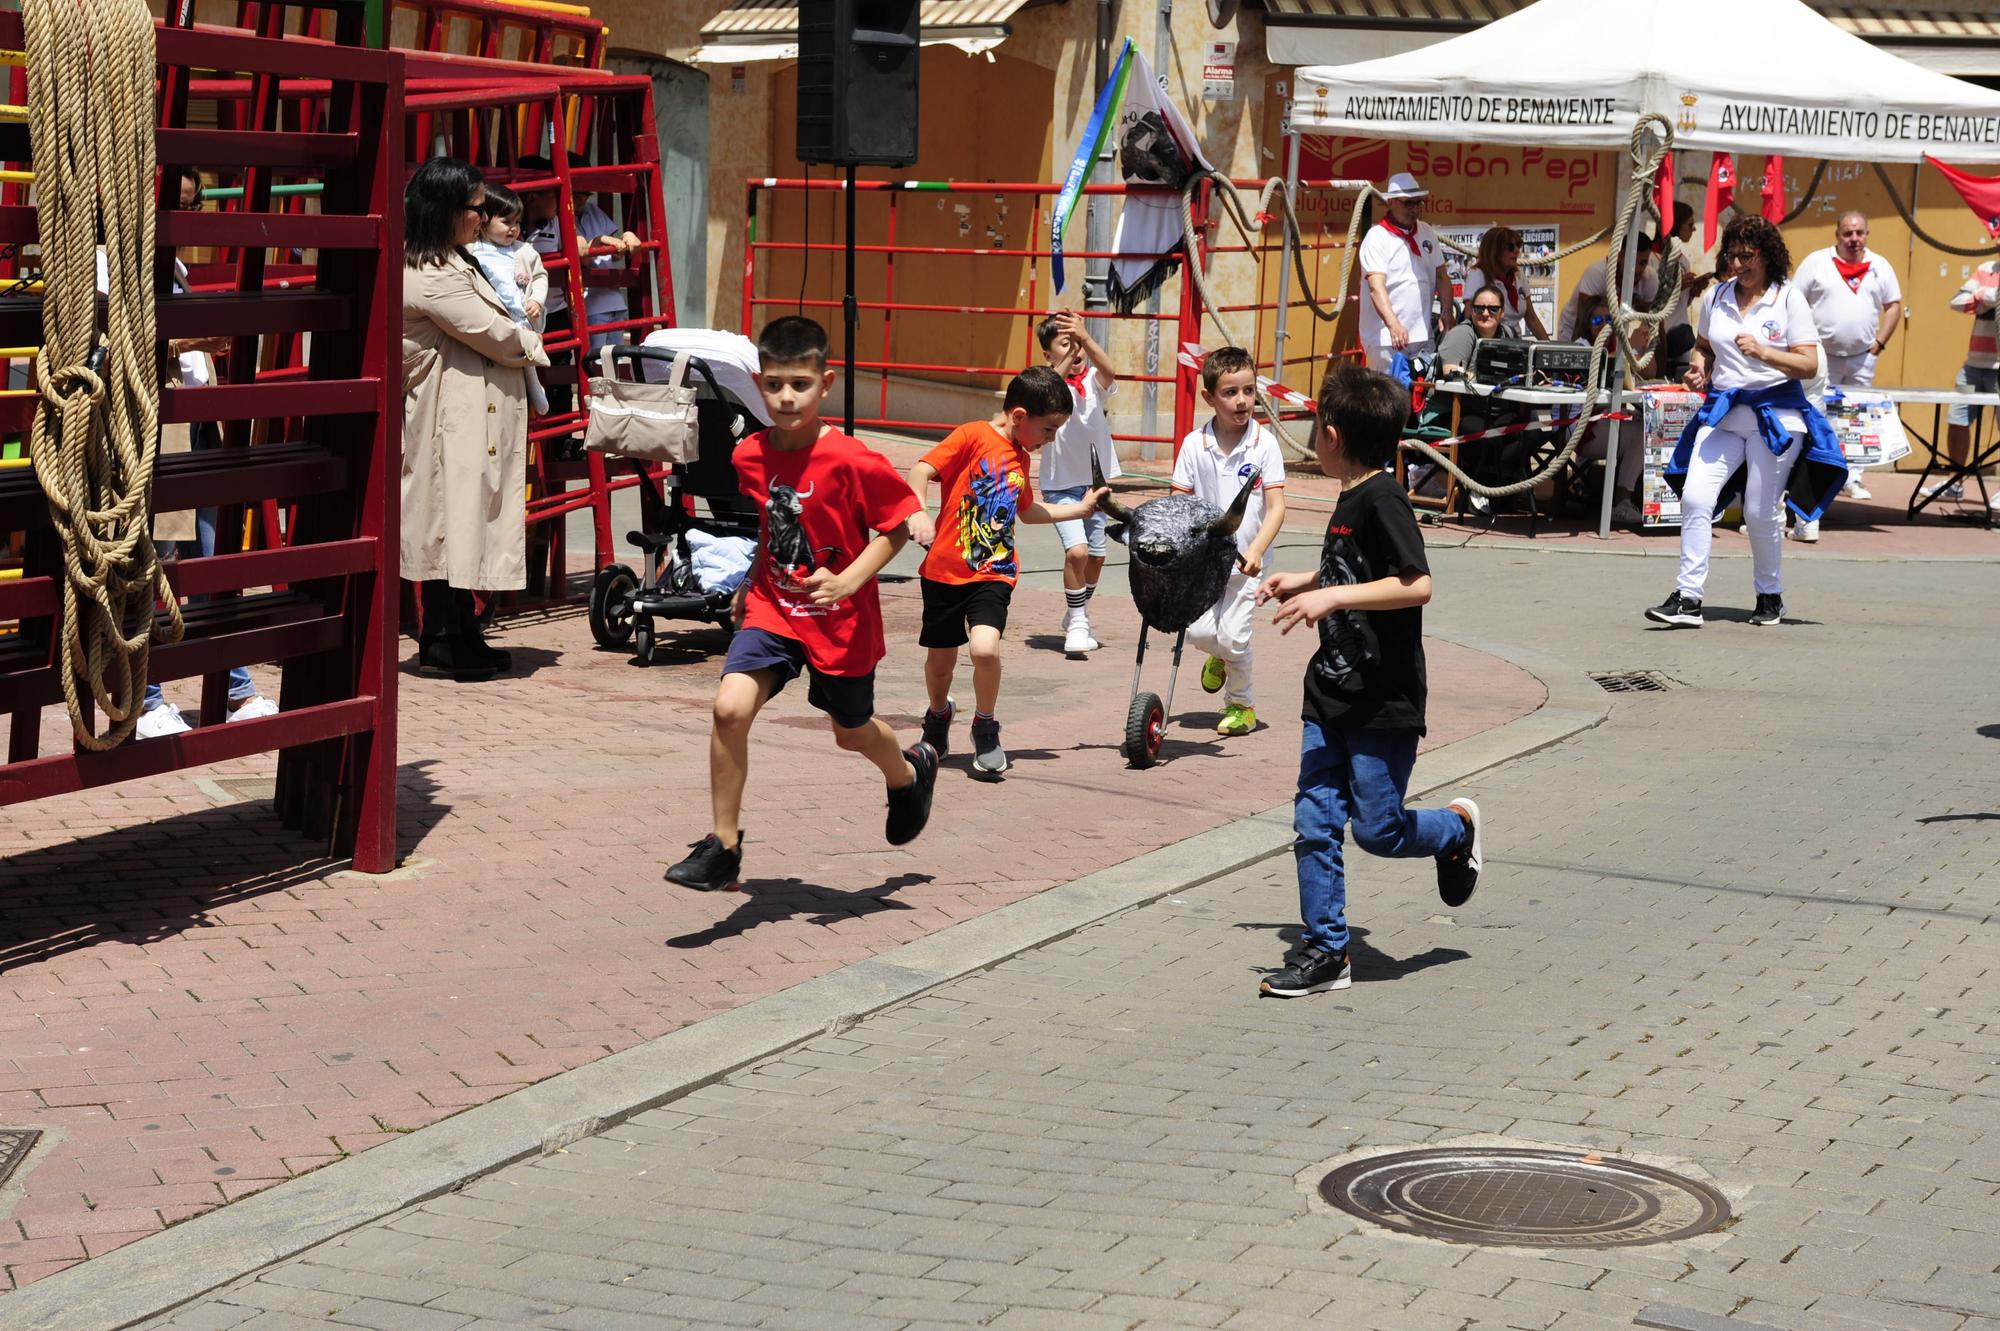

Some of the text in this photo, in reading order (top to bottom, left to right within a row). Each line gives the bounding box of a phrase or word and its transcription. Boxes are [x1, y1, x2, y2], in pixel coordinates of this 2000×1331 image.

[1205, 66, 1233, 75] Alarma
[1345, 96, 1615, 124] AYUNTAMIENTO DE BENAVENTE
[1720, 104, 1878, 138] AYUNTAMIENTO
[1885, 112, 1912, 140] DE
[1279, 191, 1358, 217] eluquer
